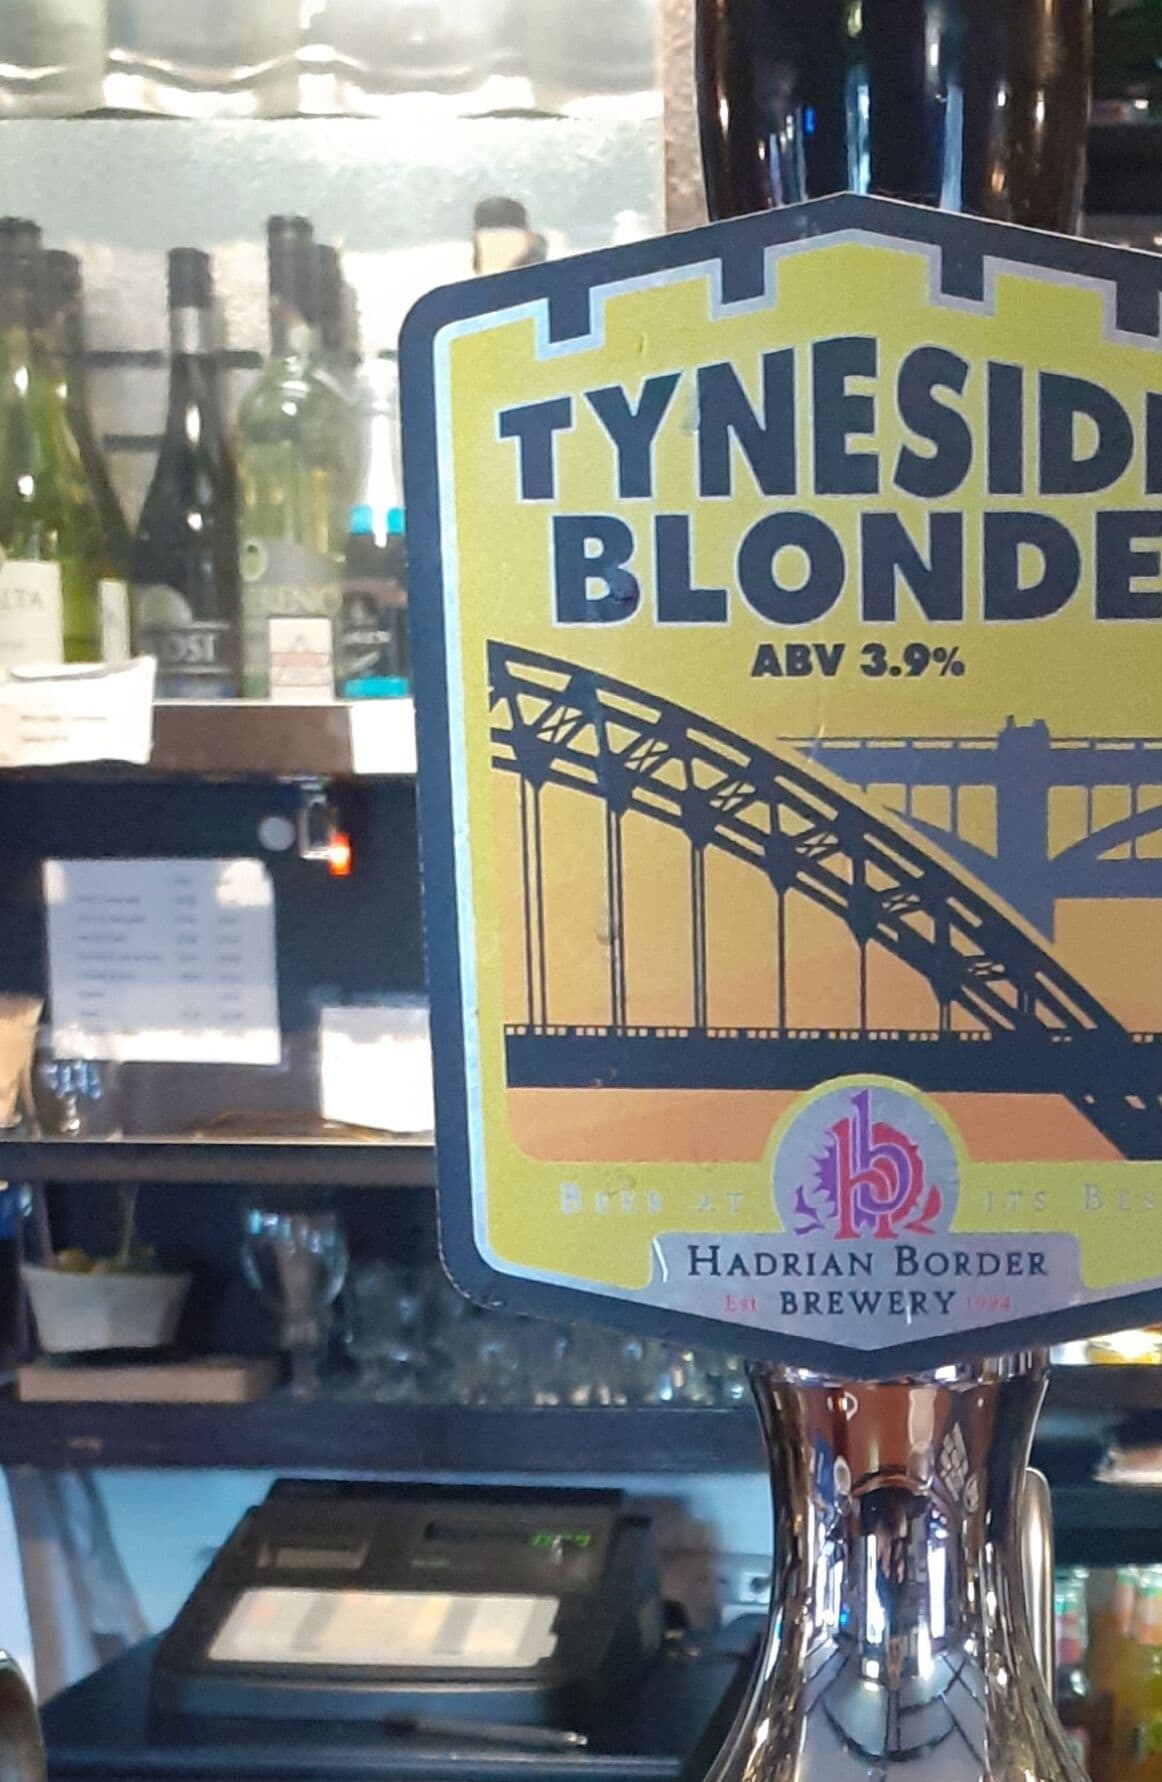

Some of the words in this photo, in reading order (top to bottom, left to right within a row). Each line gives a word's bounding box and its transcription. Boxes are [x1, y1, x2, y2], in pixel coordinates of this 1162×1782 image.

[751, 643, 845, 677] ABV
[860, 642, 966, 677] 3.9%
[688, 1245, 873, 1277] HADRIAN
[895, 1245, 1048, 1277] BORDER
[780, 1291, 957, 1315] BREWERY
